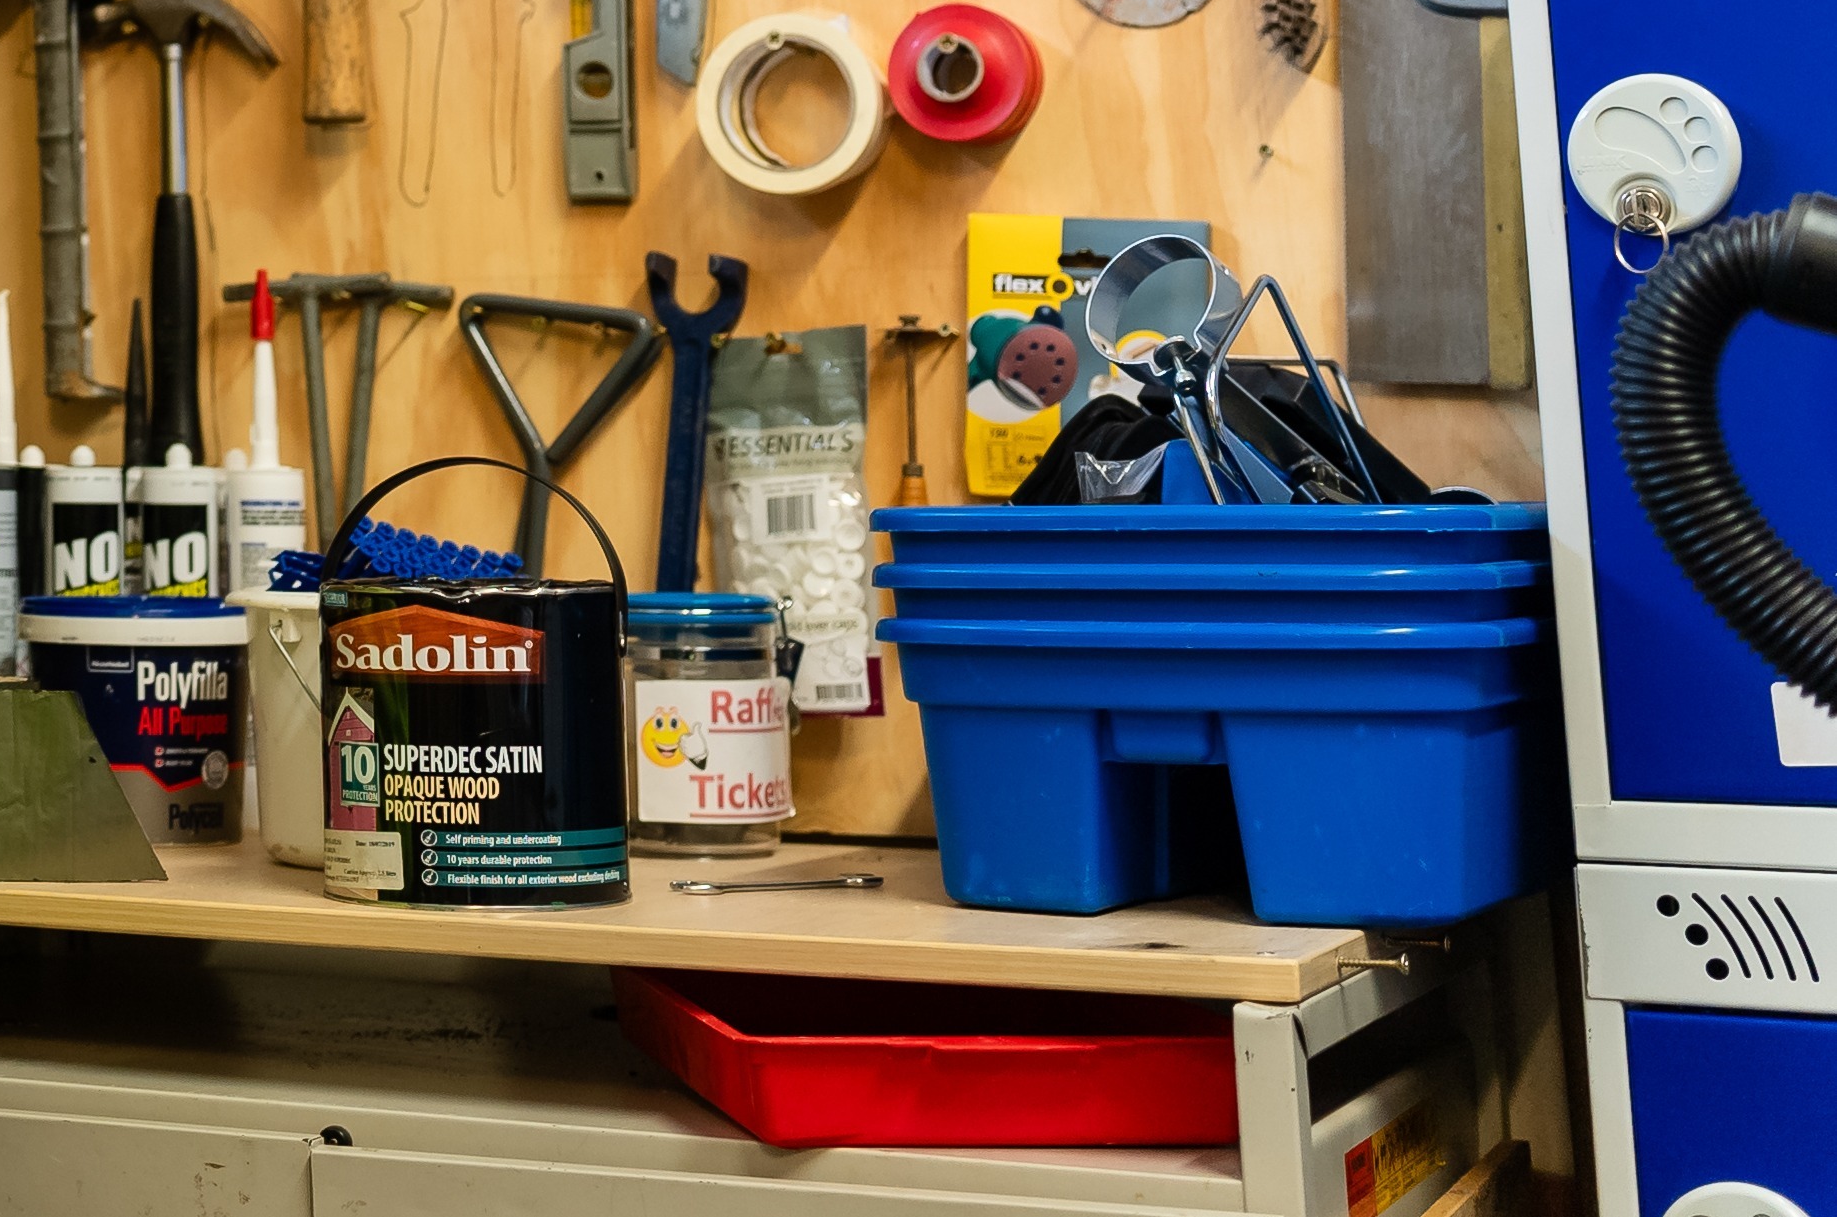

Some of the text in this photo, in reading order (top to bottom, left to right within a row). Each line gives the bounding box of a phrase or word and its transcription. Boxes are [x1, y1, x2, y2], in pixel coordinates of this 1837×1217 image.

[729, 430, 854, 457] ESSENTIALS
[54, 530, 119, 592] NO
[144, 530, 208, 592] NO
[336, 633, 532, 672] Sadolin
[137, 660, 228, 709] Polyfilla
[138, 706, 228, 742] All Purpose
[341, 744, 376, 785] 10
[383, 743, 543, 774] SUPERDEC SATIN
[342, 788, 378, 802] PROTECTION
[384, 774, 500, 801] OPAQUE WOOD
[385, 799, 480, 825] PROTECTION
[445, 834, 562, 847] Self priming and undercoating
[446, 854, 552, 867] 10 years durable protection
[447, 873, 479, 884] Flexible
[480, 874, 503, 885] finish
[504, 874, 516, 884] for
[517, 874, 527, 884] all
[528, 874, 558, 884] exterior
[558, 873, 577, 883] wood
